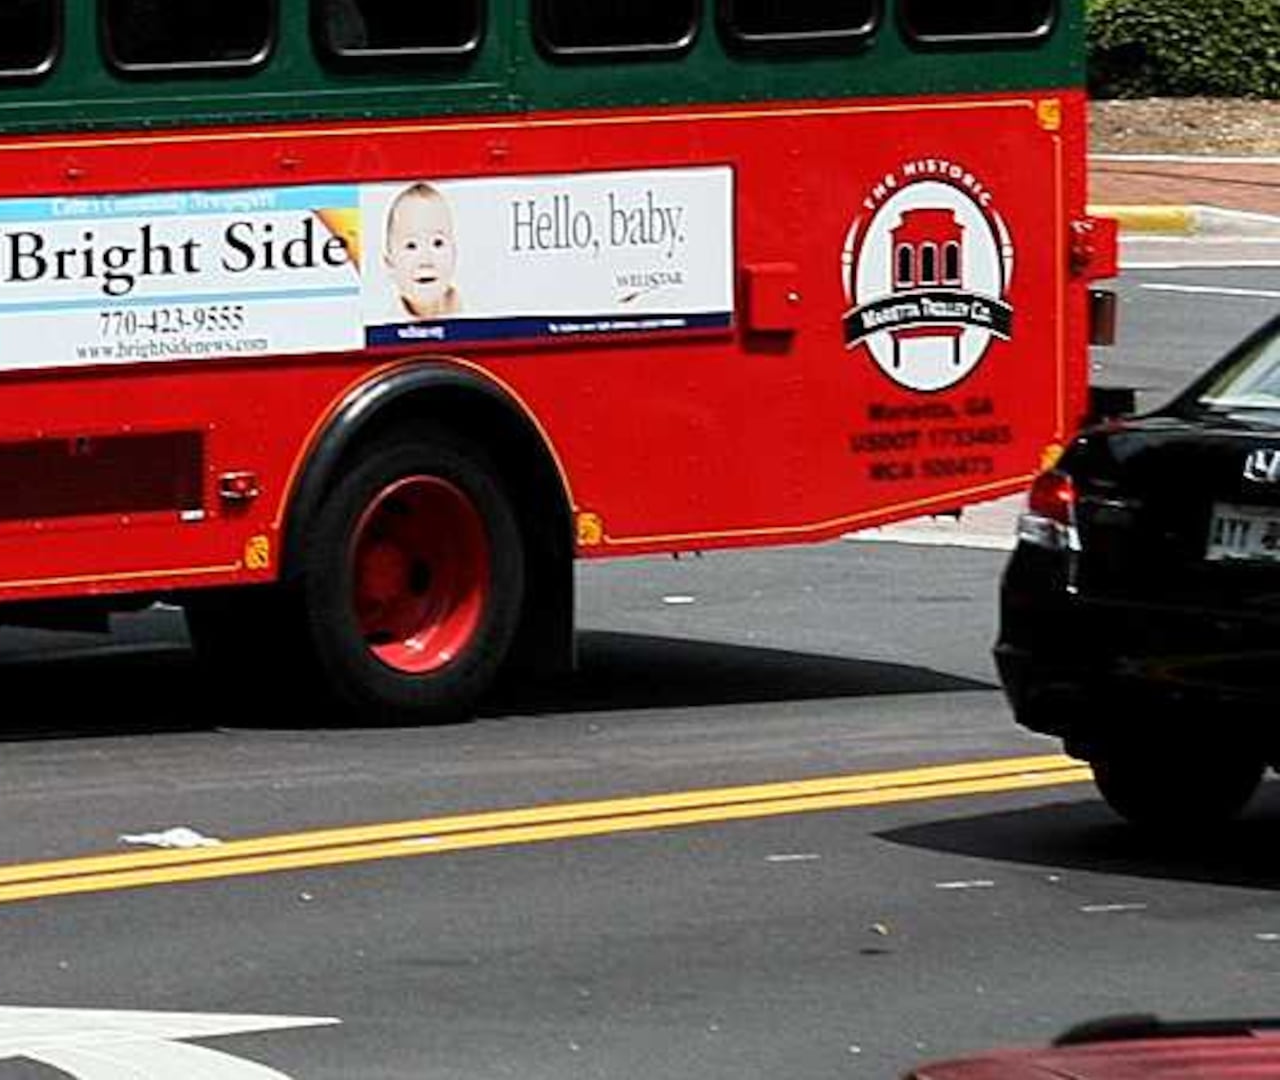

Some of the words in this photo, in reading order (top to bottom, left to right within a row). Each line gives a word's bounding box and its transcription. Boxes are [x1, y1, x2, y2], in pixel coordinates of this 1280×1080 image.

[862, 173, 897, 210] THE
[903, 157, 993, 208] HISTORIC
[512, 194, 600, 257] Hello,
[607, 190, 685, 259] baby.
[6, 224, 202, 296] Bright
[221, 218, 348, 272] Side
[99, 304, 244, 337] 770-423-9555
